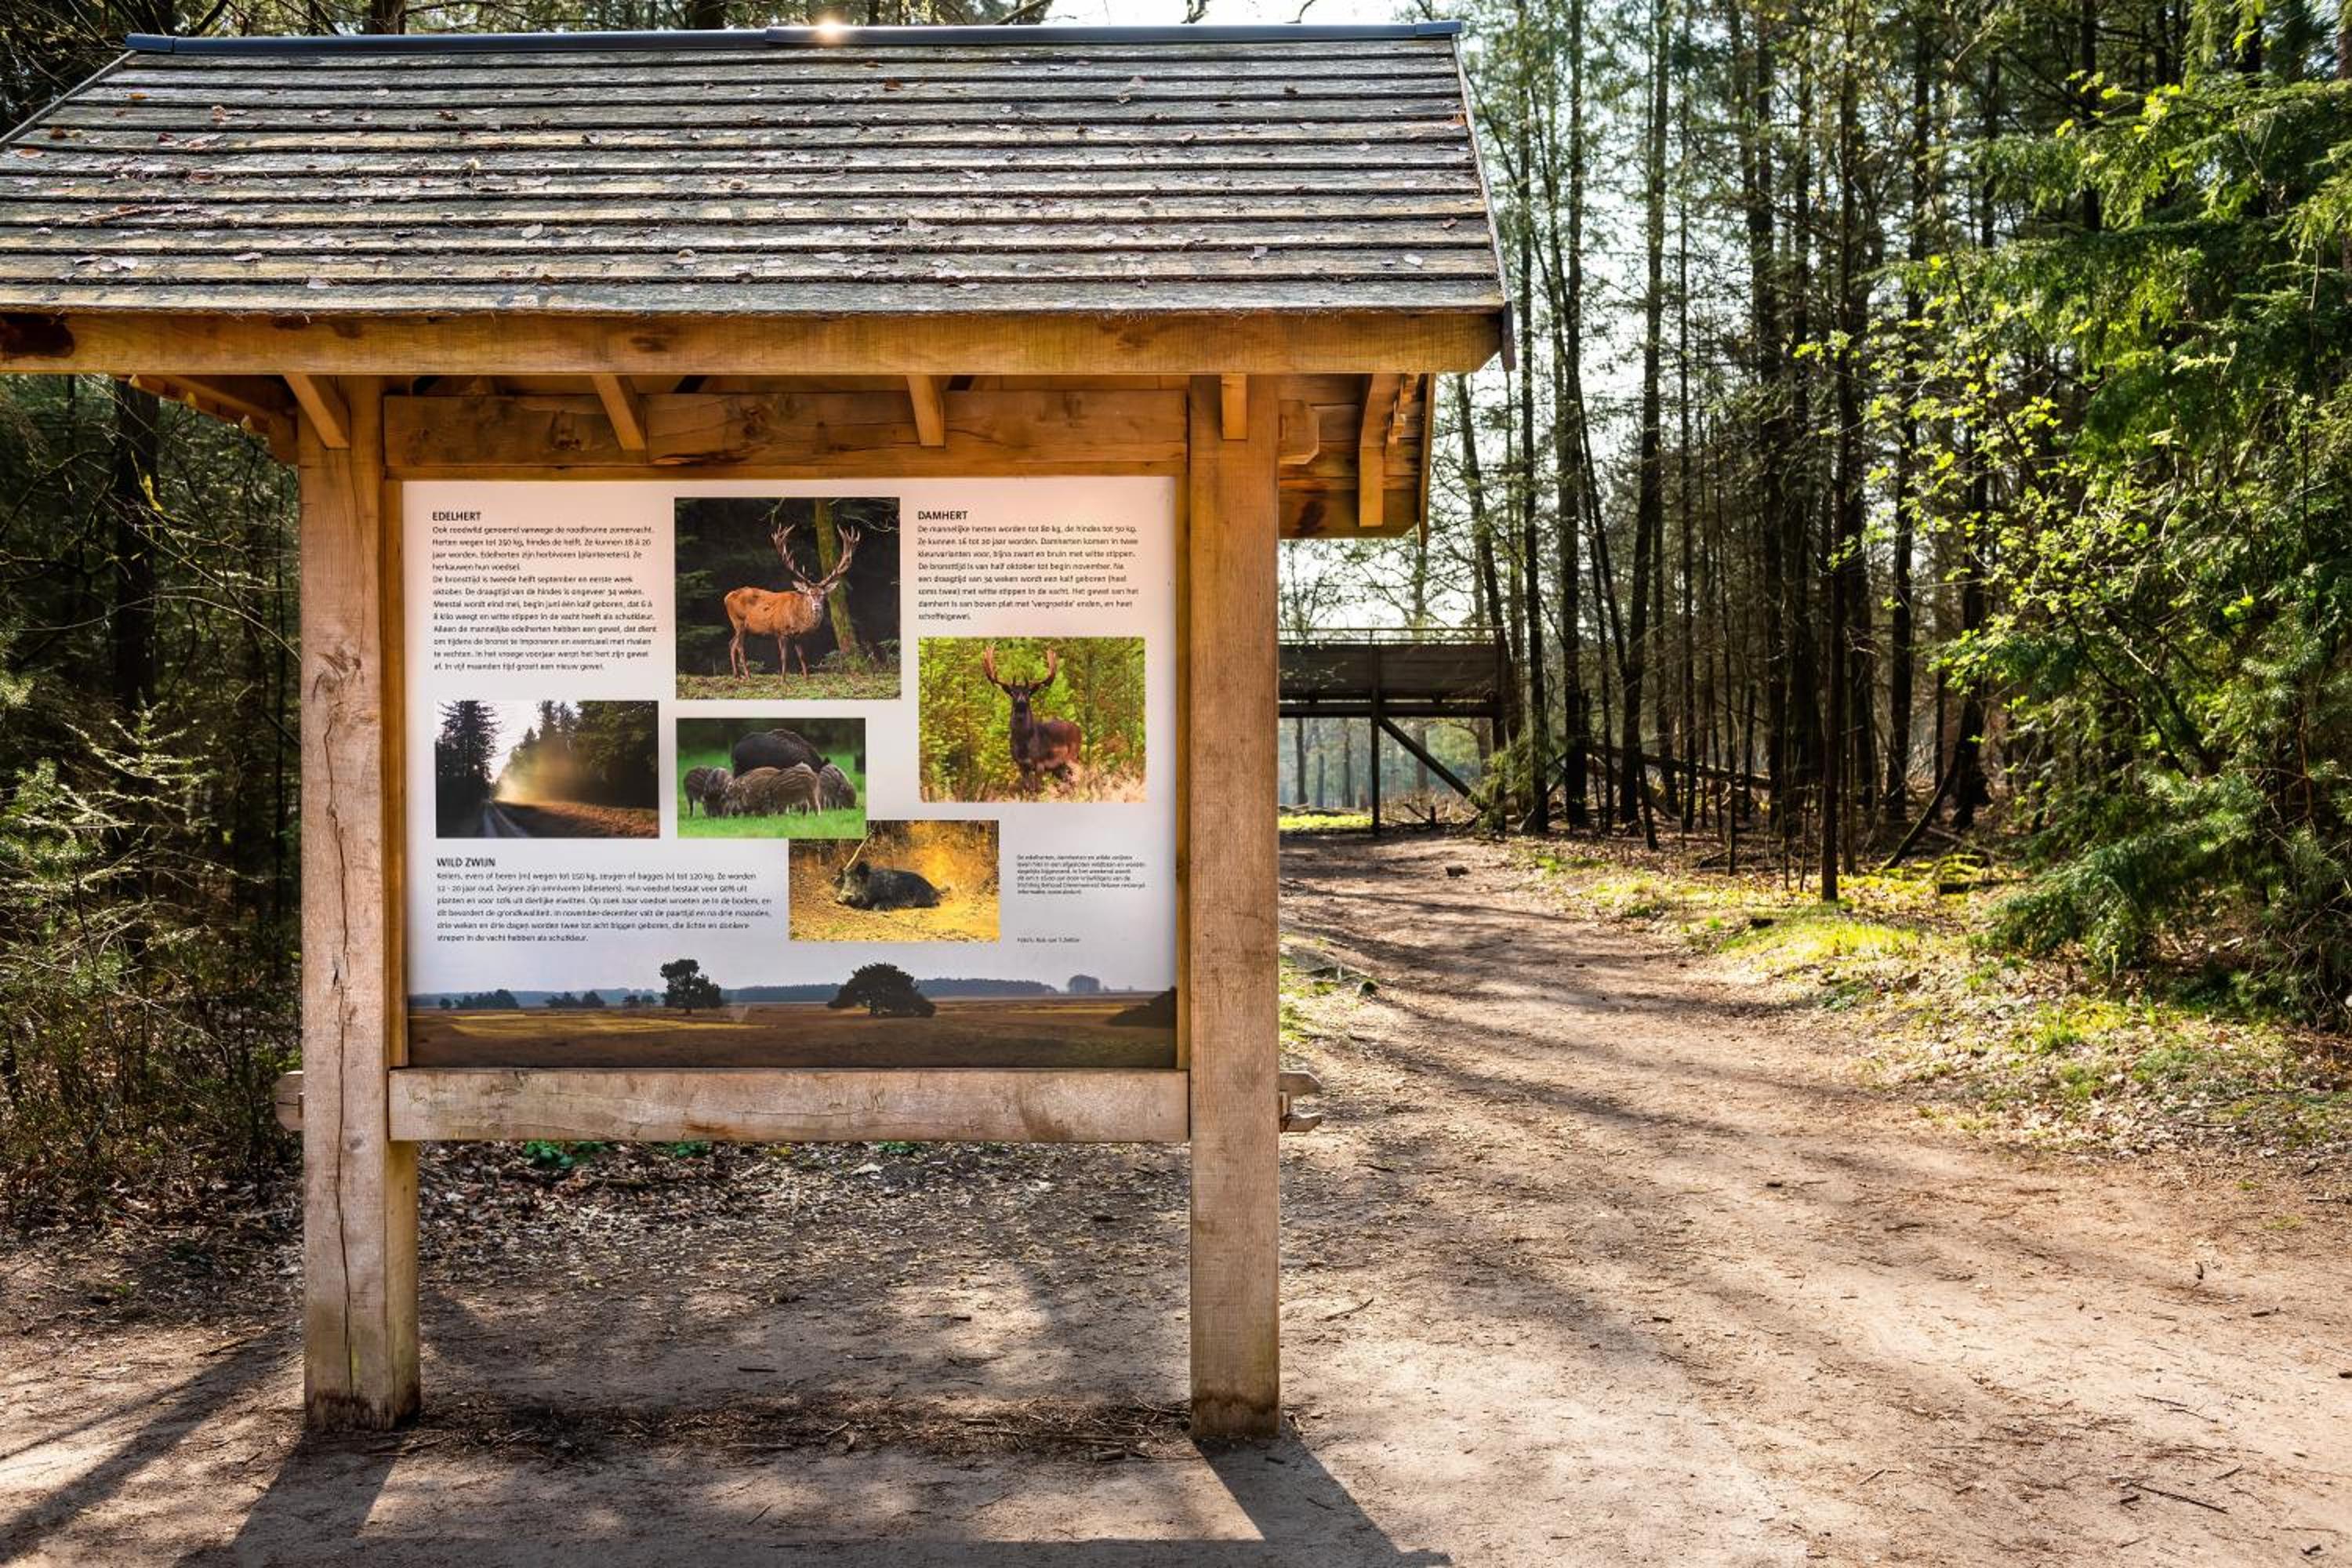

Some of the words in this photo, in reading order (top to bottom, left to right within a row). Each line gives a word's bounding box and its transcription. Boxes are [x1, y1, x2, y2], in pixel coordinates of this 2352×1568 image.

[432, 510, 481, 521] EDELHERT
[918, 509, 968, 521] DAMHERT
[437, 856, 463, 867] WILD
[466, 856, 495, 867] ZWIJN
